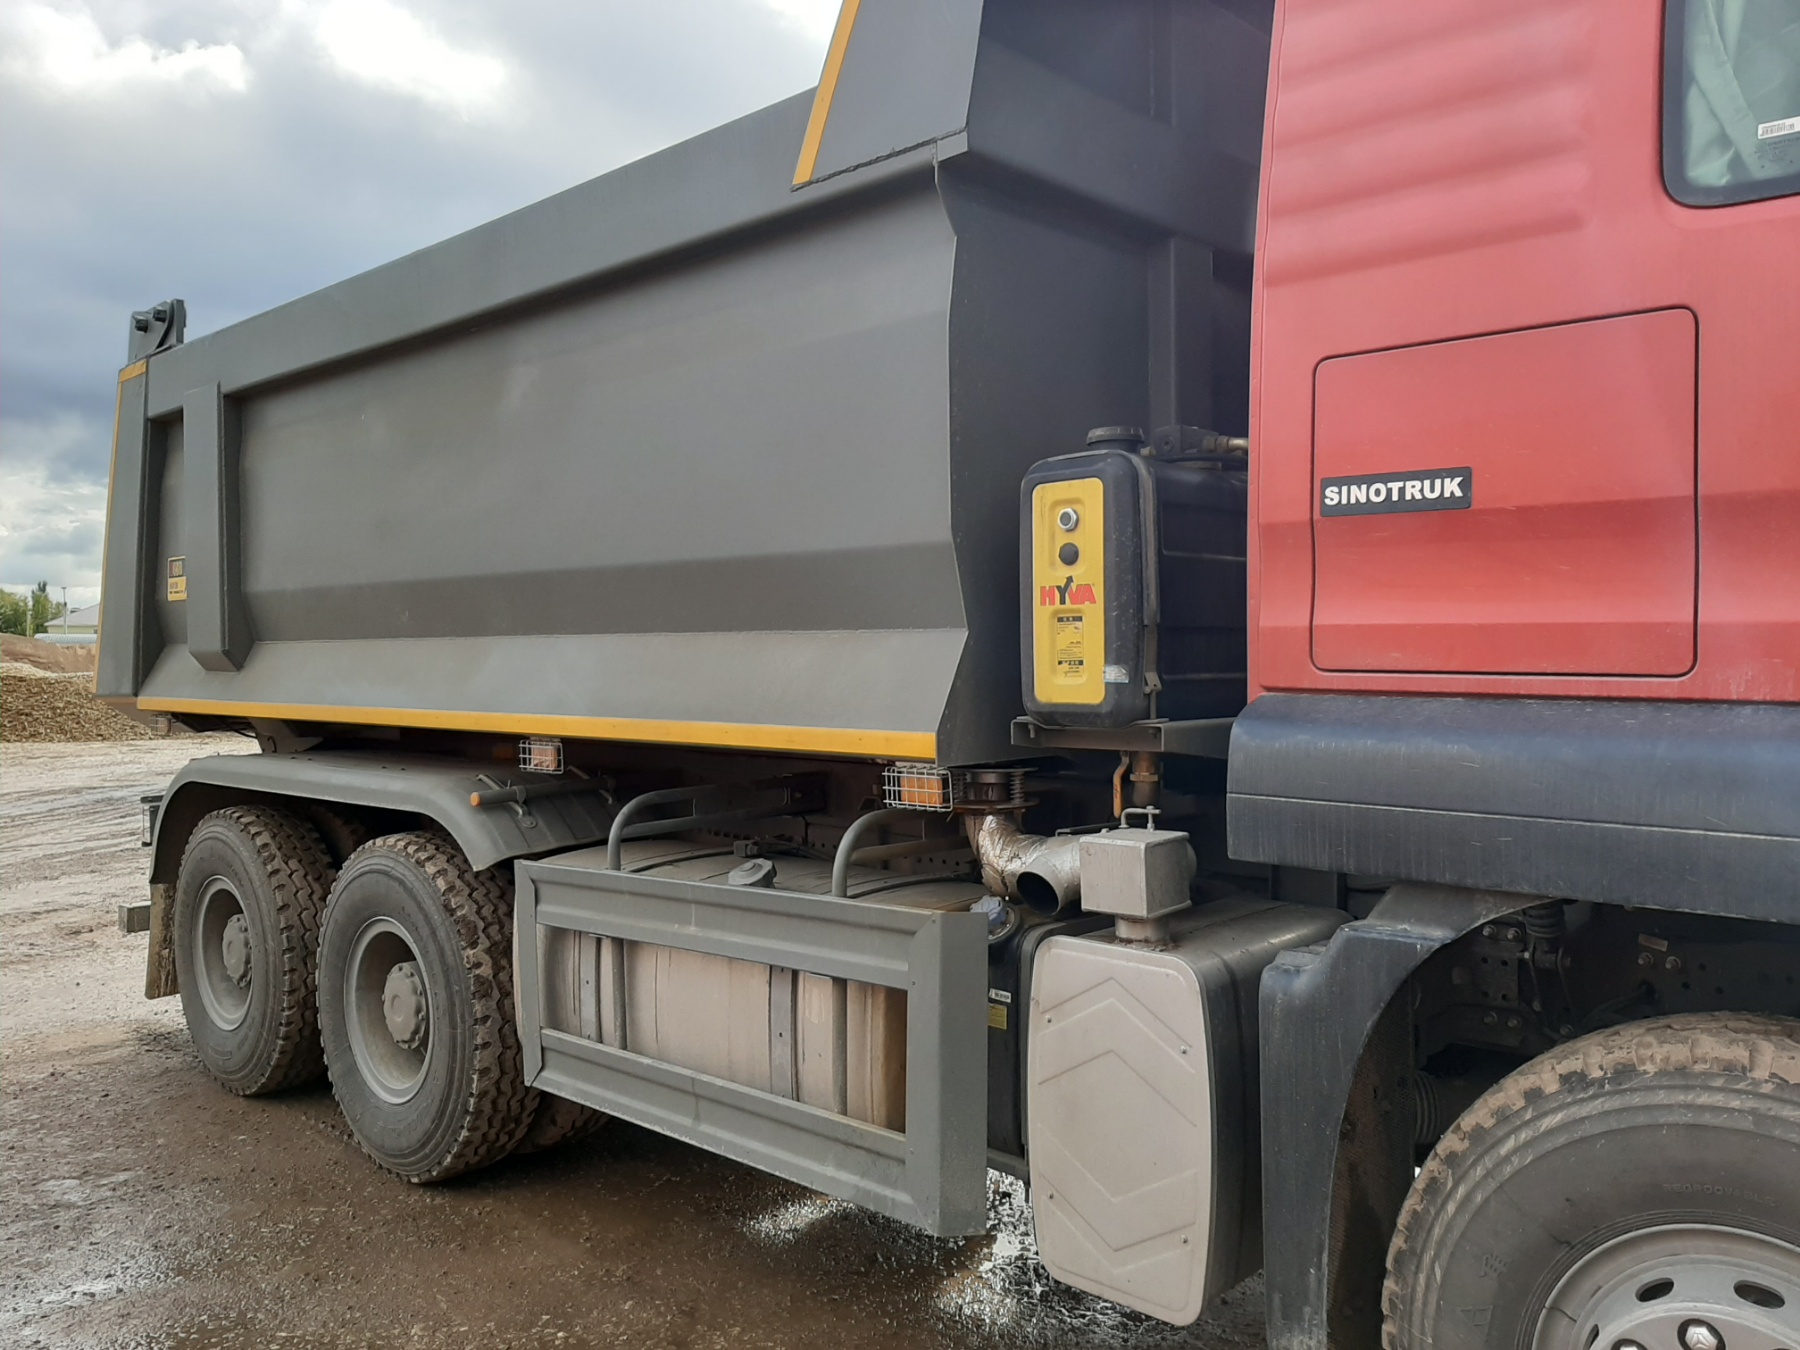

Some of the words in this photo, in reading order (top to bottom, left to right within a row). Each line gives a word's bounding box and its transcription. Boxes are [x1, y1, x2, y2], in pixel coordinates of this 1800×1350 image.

[1324, 476, 1464, 506] SINOTRUK
[1040, 575, 1097, 607] HYVA
[1661, 1182, 1777, 1208] REGROOVBLE
